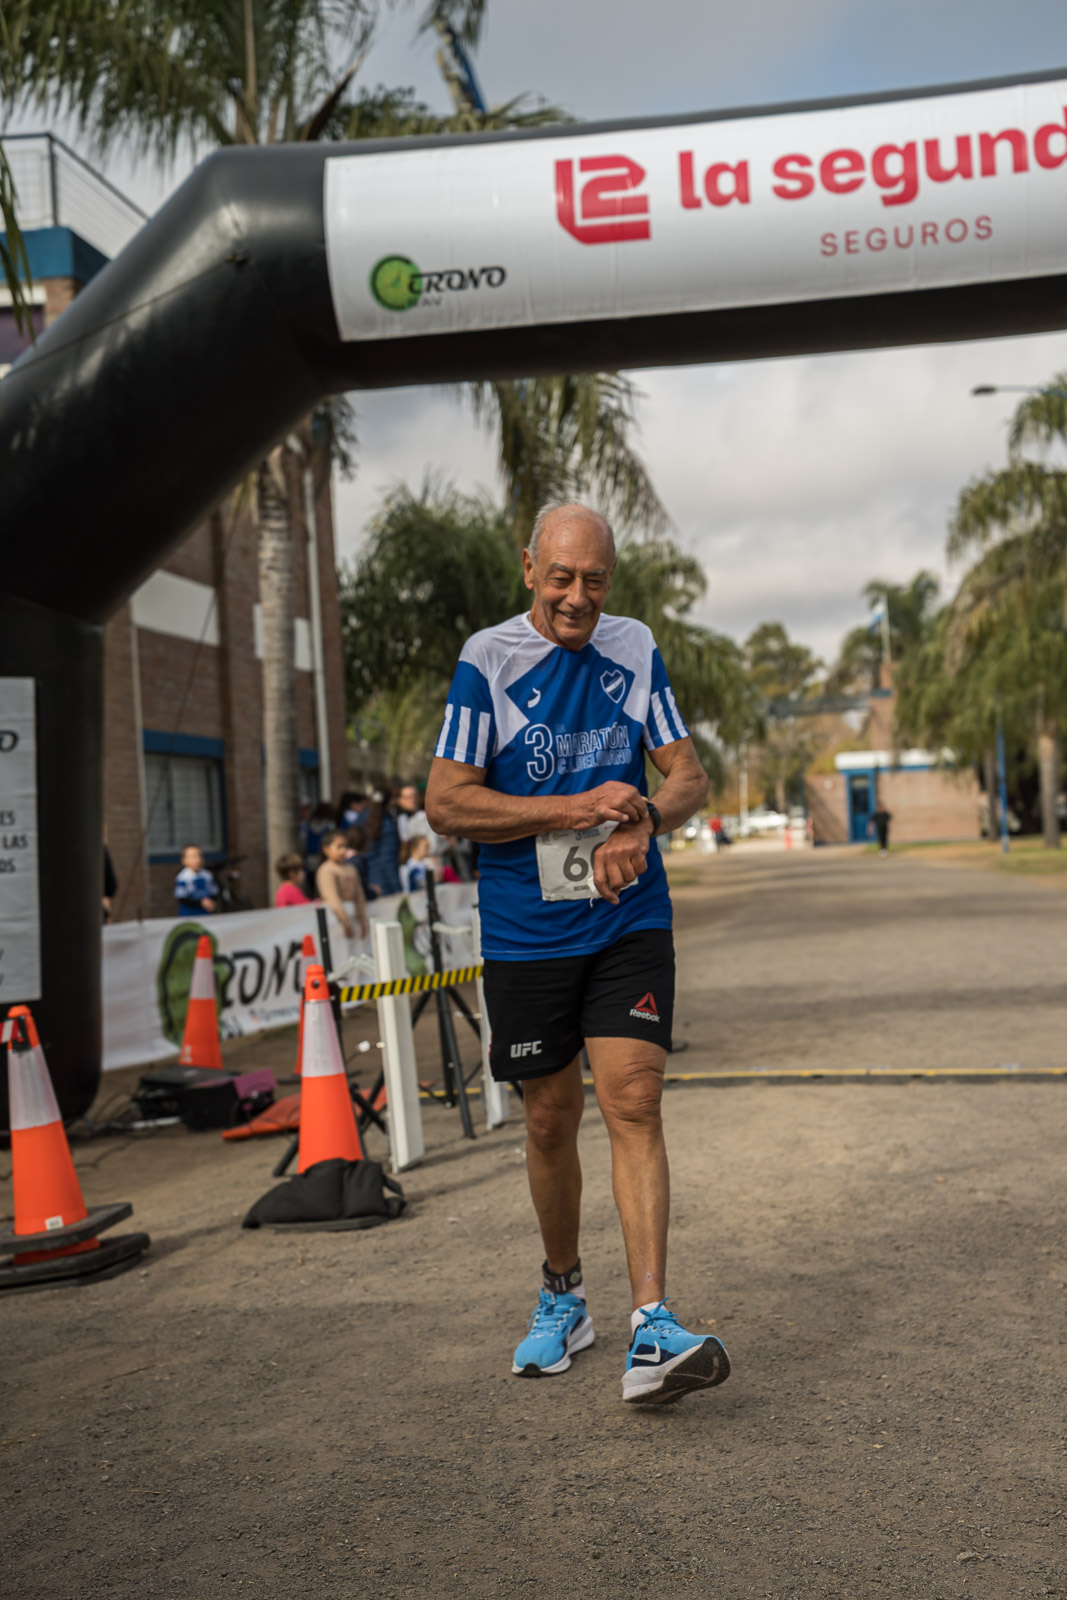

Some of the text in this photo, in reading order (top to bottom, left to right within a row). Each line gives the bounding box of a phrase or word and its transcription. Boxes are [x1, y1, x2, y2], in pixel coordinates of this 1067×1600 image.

[678, 150, 751, 210] la
[819, 214, 994, 258] SEGUROS
[525, 723, 555, 782] 3
[3, 834, 28, 850] LAS
[563, 842, 606, 882] 6
[629, 1008, 661, 1023] Reebok
[510, 1040, 543, 1058] UFC
